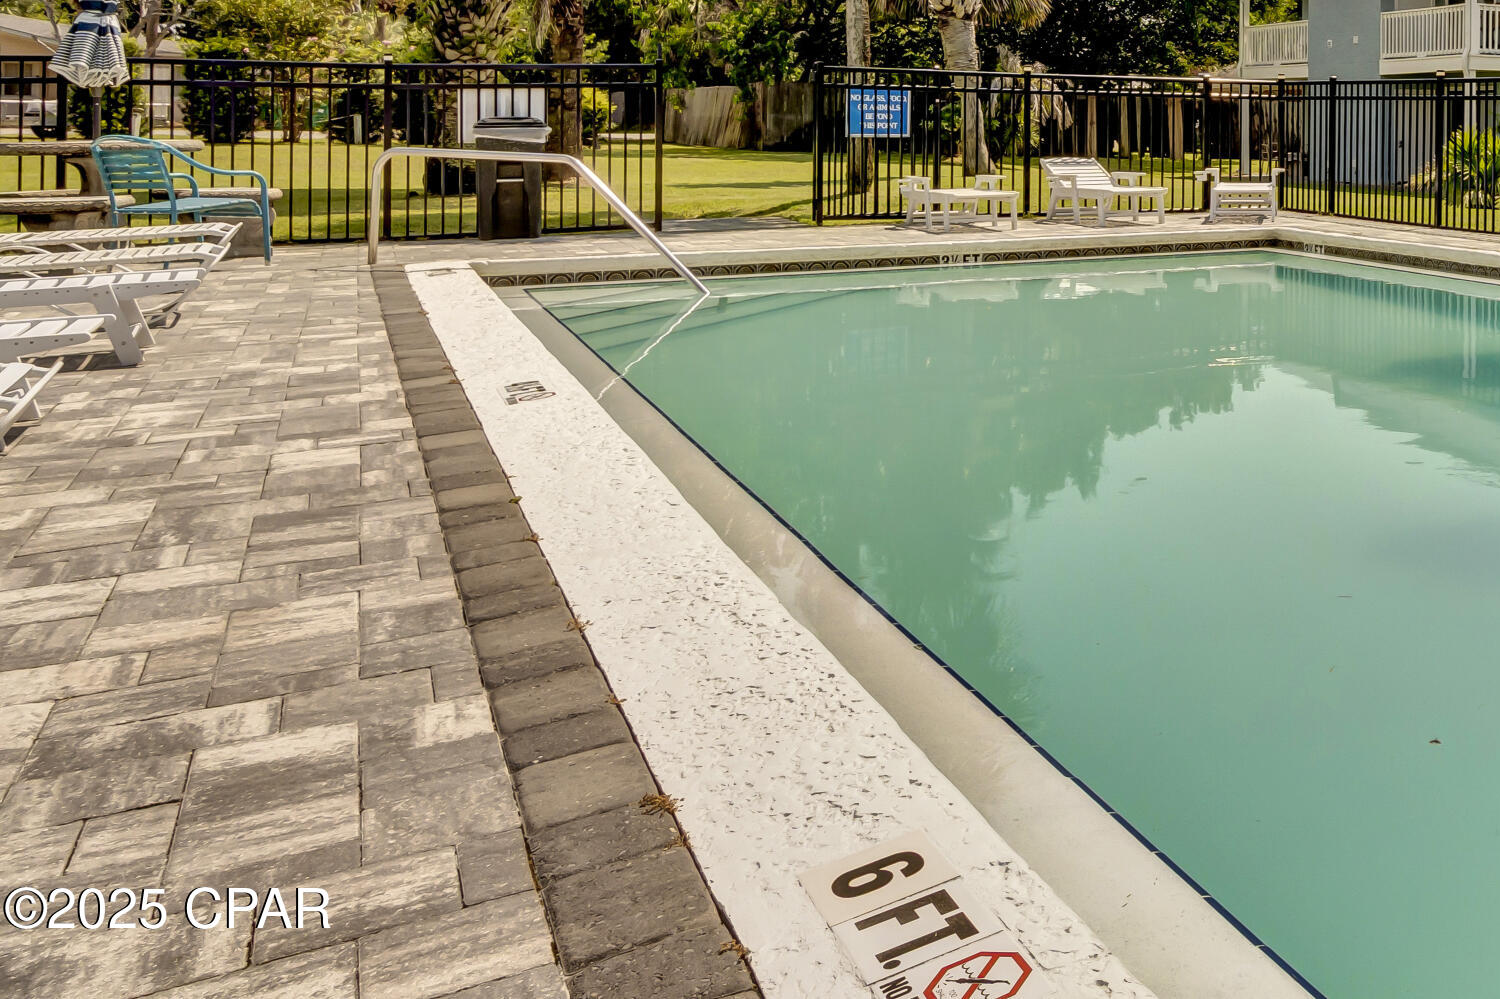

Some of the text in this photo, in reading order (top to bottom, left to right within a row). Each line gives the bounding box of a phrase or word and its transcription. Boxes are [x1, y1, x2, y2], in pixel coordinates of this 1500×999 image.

[963, 254, 980, 264] FT
[831, 851, 925, 898] 6
[880, 976, 913, 999] NO
